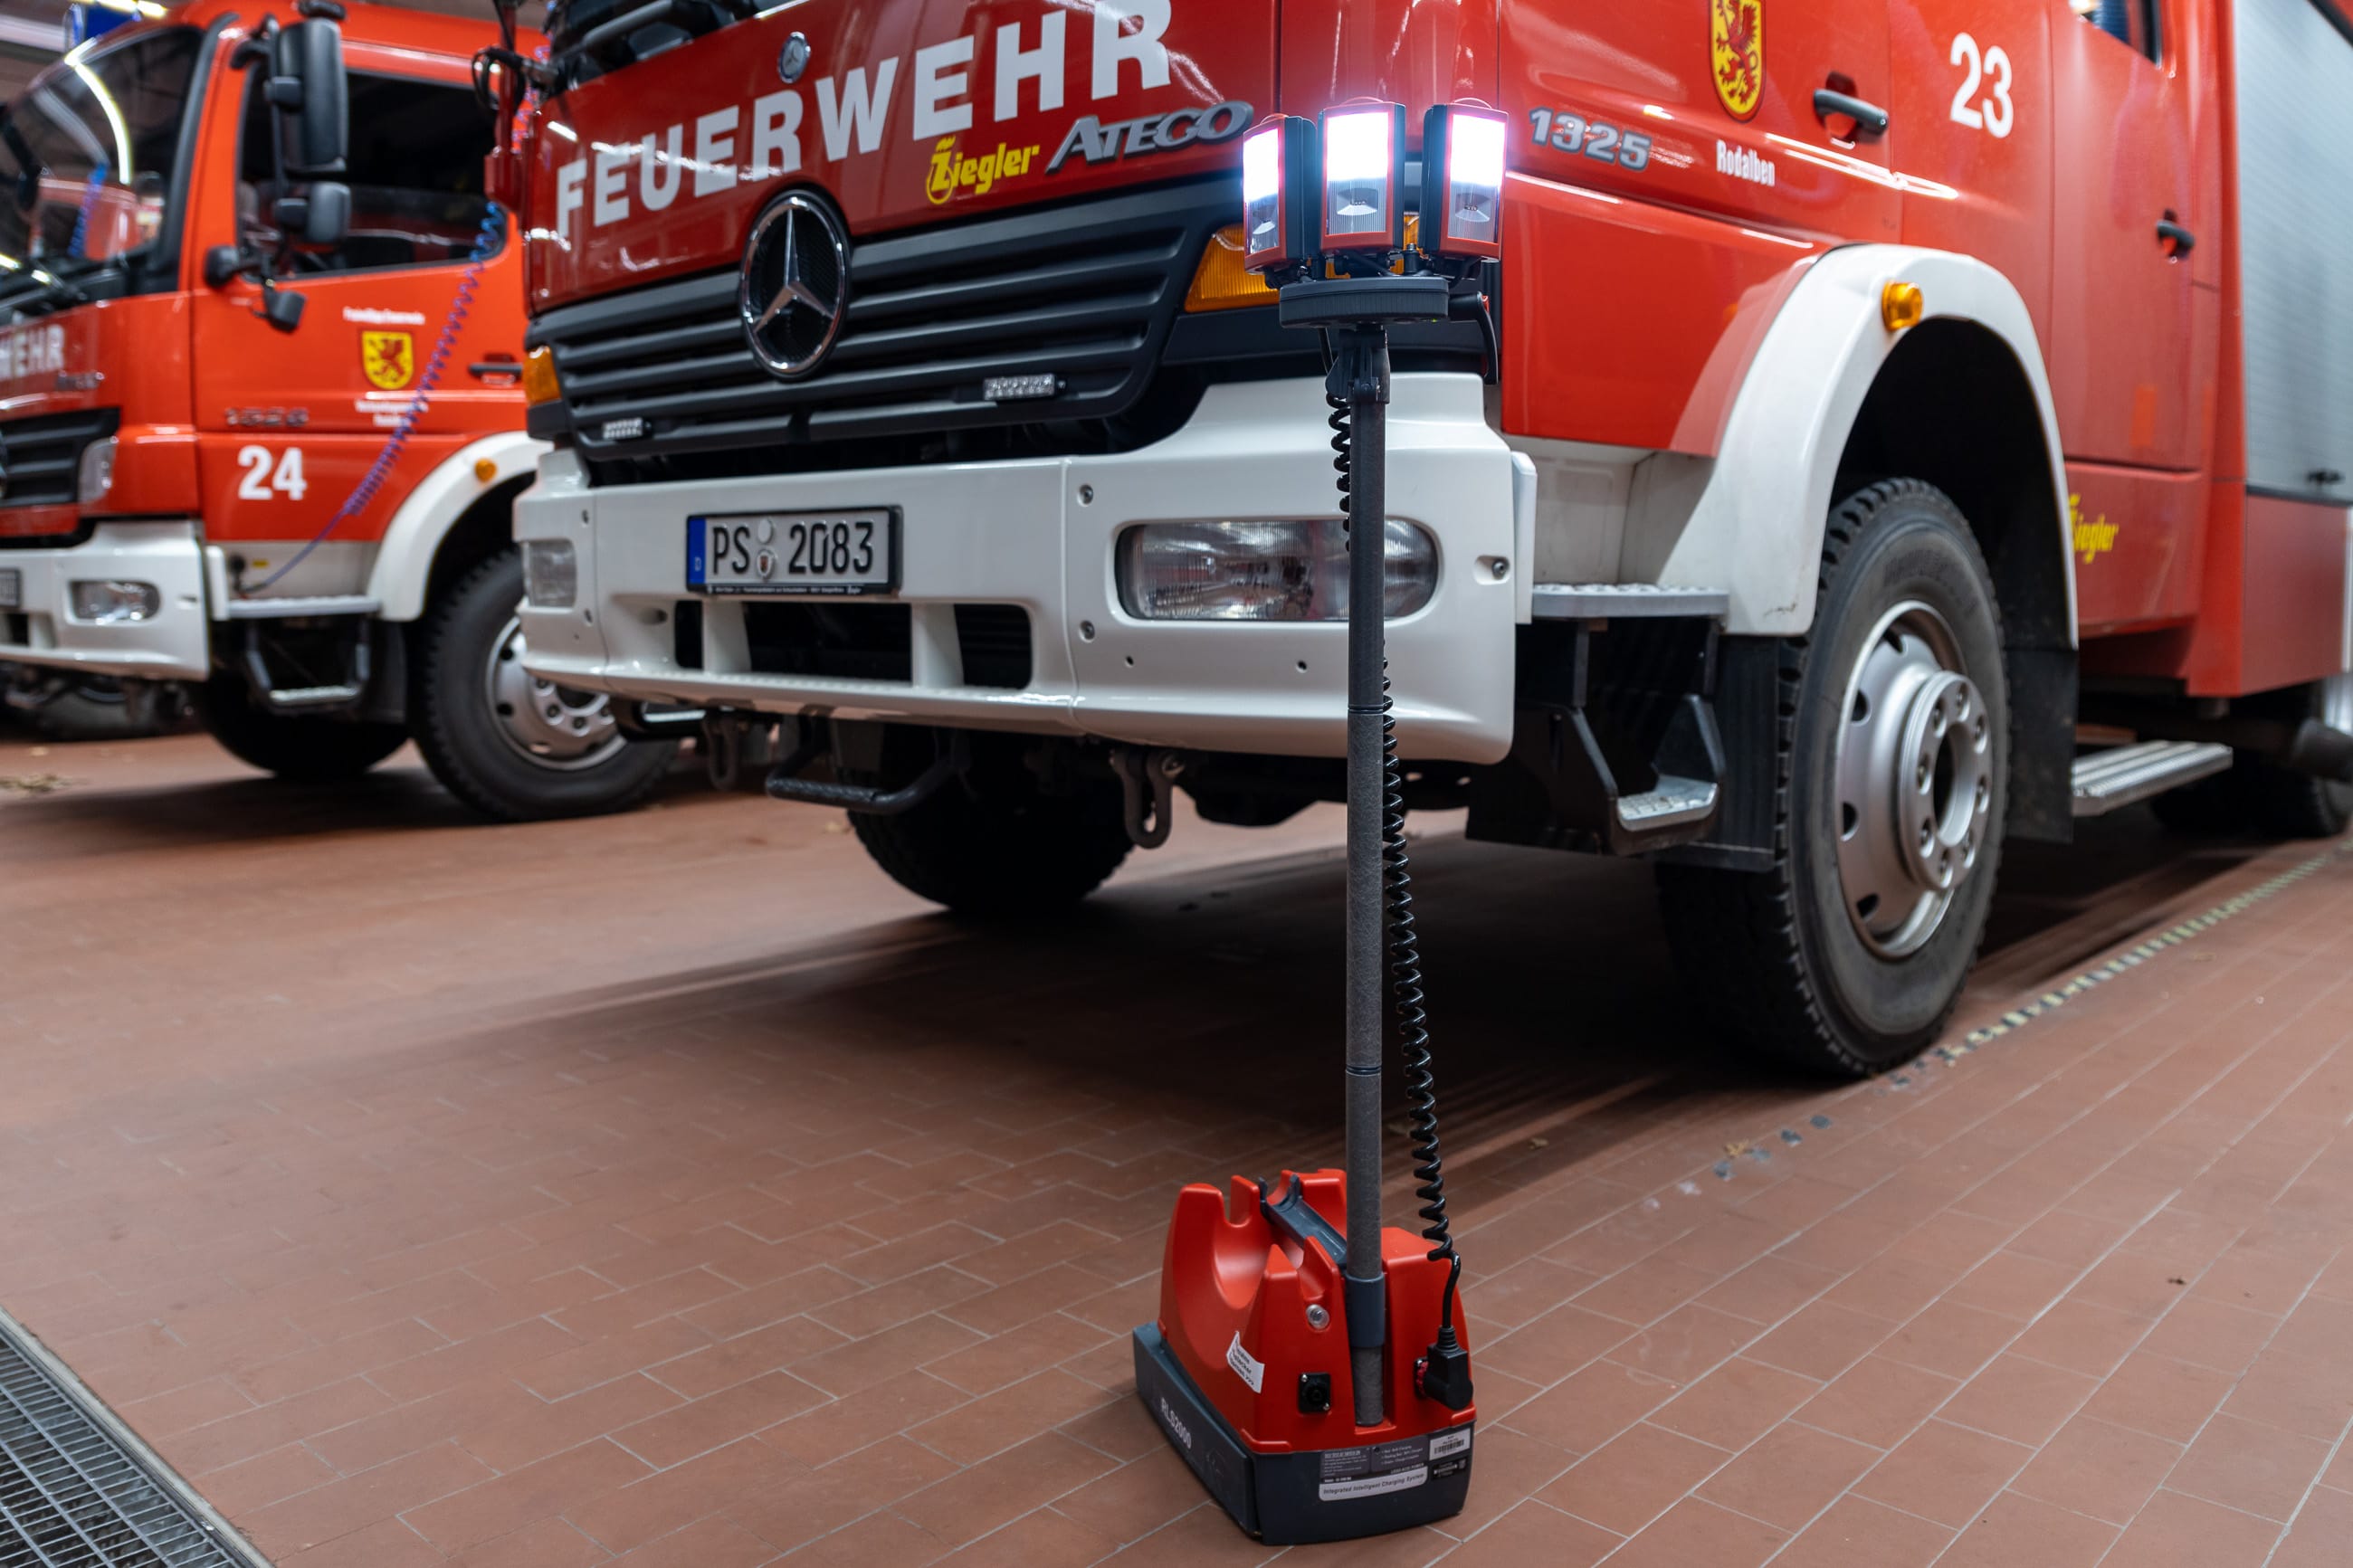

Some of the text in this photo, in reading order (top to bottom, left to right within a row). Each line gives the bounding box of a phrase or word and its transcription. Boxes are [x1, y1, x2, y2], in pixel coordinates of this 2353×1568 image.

[1949, 32, 2014, 138] 23
[556, 0, 1171, 239] FEUERWEHR
[1529, 106, 1652, 172] 1325
[927, 135, 1040, 205] Ziegler
[1716, 139, 1776, 187] Rodalben
[237, 444, 308, 501] 24
[712, 520, 874, 575] PS 2083
[1160, 1397, 1192, 1449] RLS2000
[1323, 1486, 1352, 1495] Integrated
[1382, 1477, 1405, 1487] Charging
